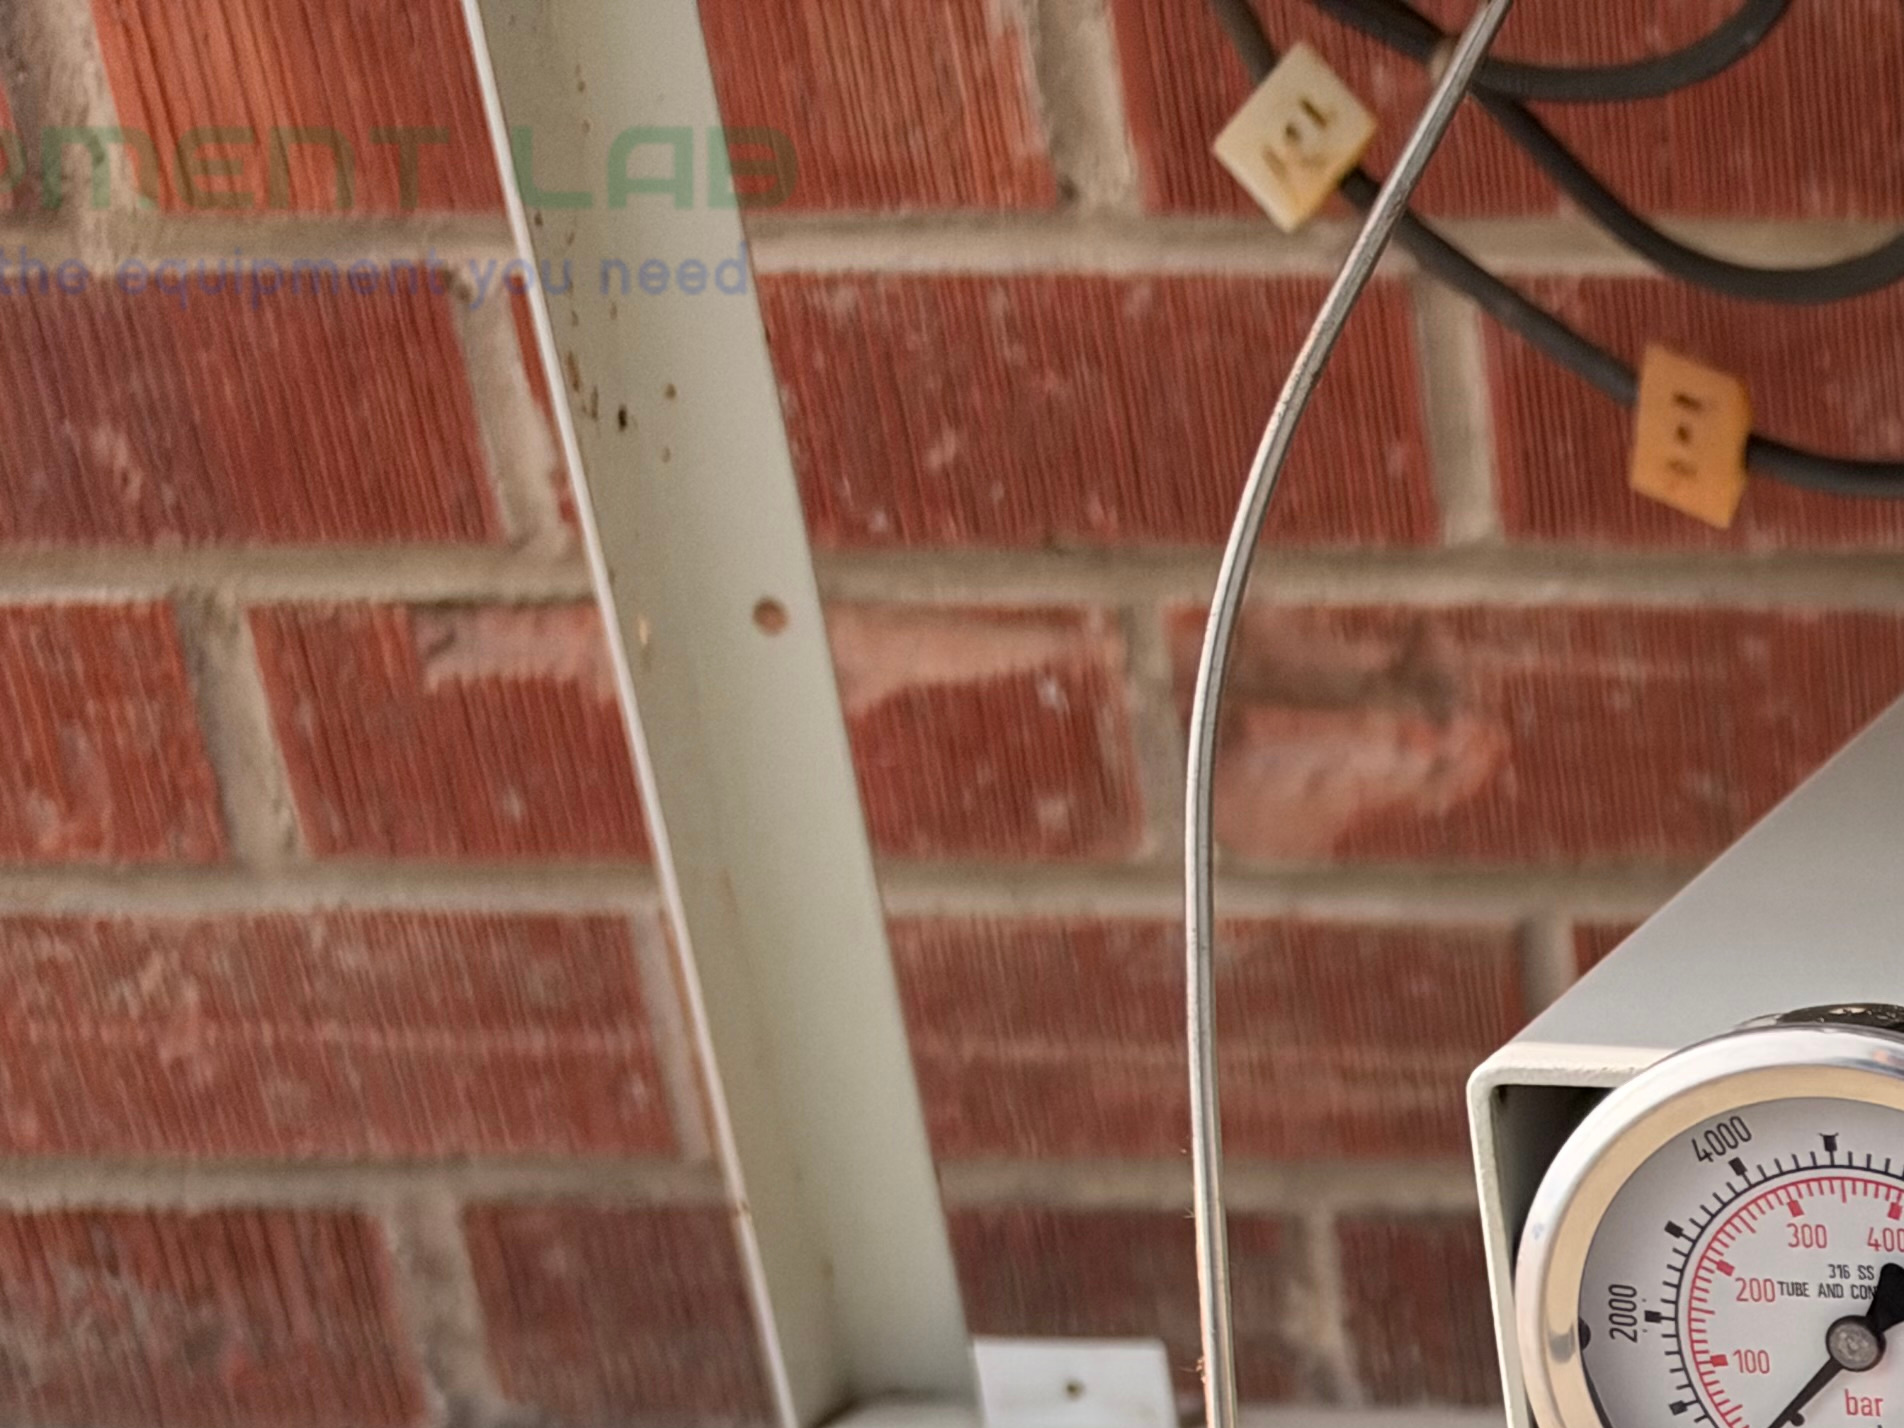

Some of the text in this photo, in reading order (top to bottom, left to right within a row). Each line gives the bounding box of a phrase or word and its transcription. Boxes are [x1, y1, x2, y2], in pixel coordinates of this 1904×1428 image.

[1691, 1115, 1752, 1164] 4000
[1787, 1223, 1828, 1249] 300
[1828, 1264, 1874, 1280] 316 SS
[1735, 1278, 1776, 1303] 200
[1777, 1281, 1878, 1300] TUBE AND CON
[1608, 1284, 1638, 1343] 2000
[1733, 1350, 1770, 1374] 100
[1845, 1389, 1883, 1417] bar
